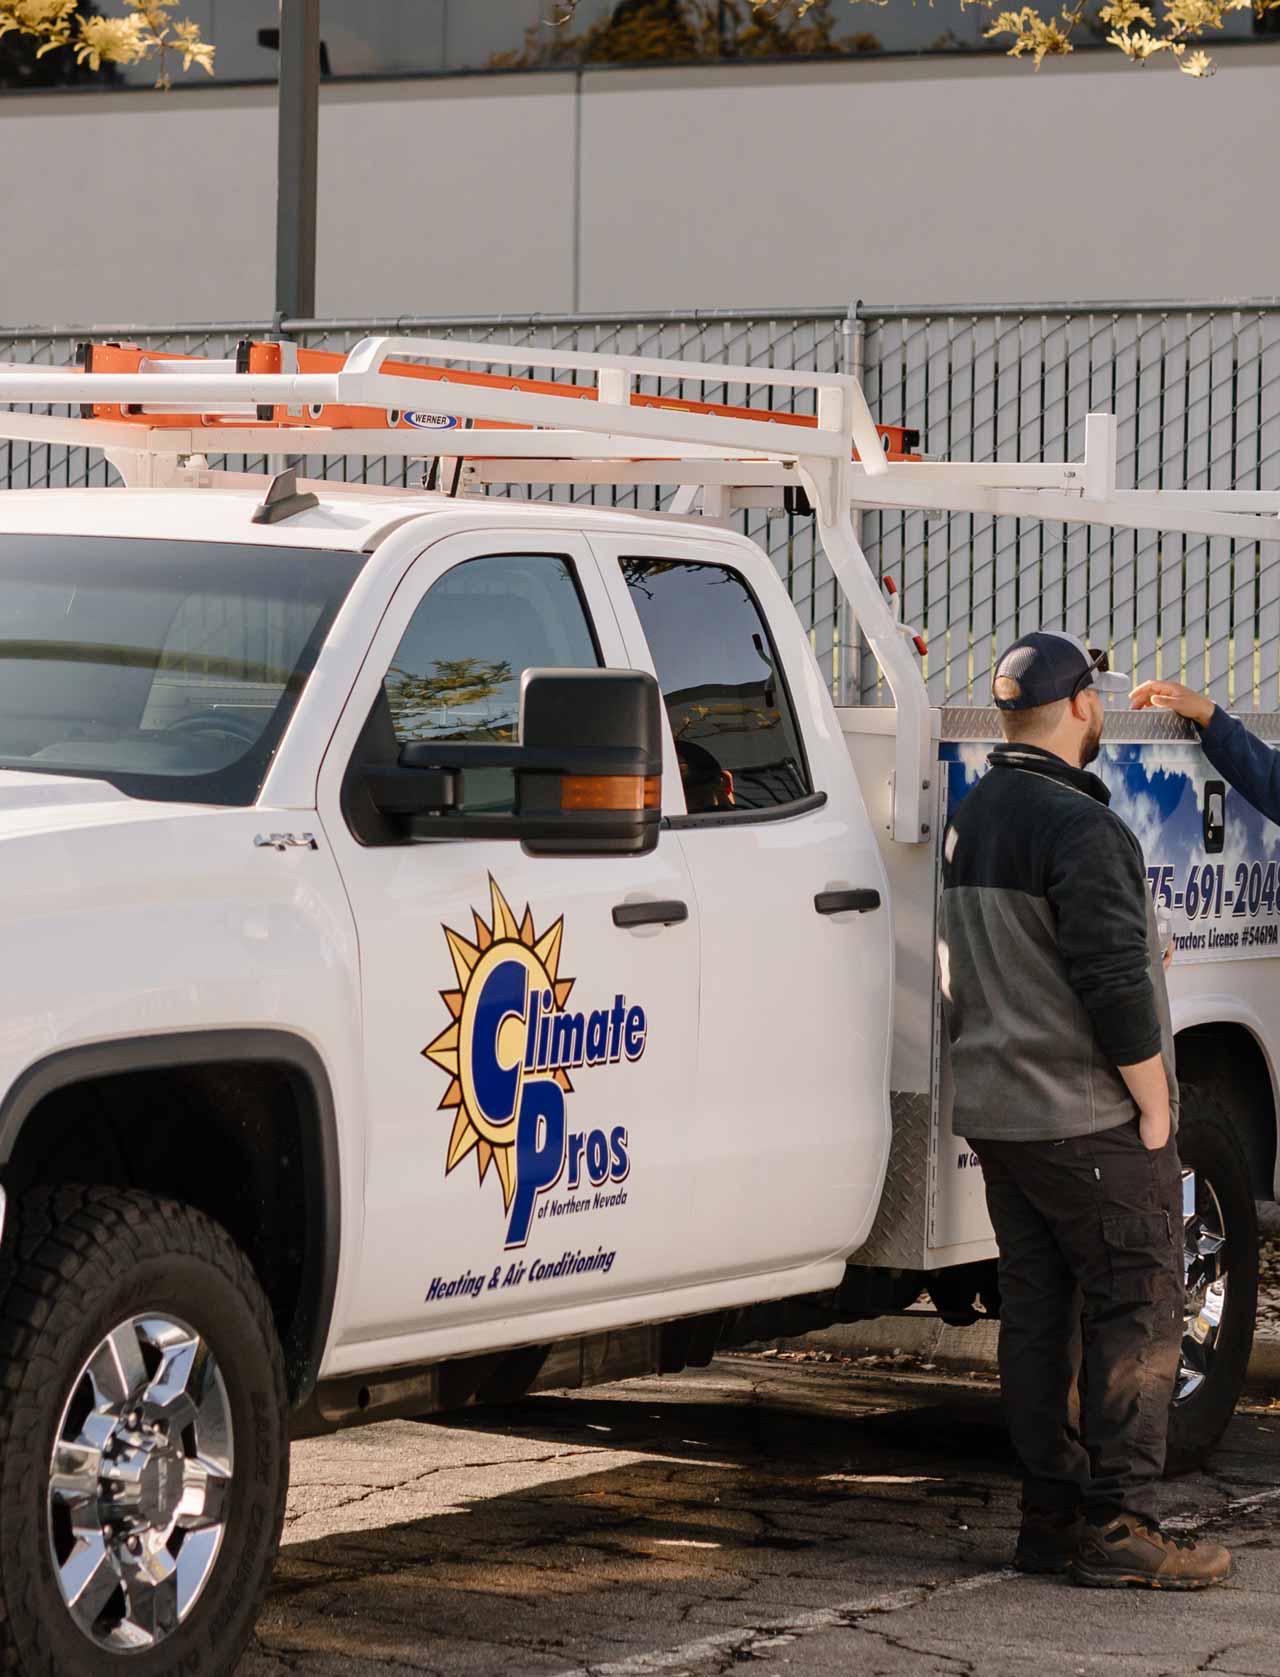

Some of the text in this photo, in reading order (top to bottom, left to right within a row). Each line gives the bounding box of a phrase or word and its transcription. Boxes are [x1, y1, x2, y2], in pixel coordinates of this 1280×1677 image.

[415, 414, 447, 424] WERNER
[1208, 928, 1239, 949] License
[471, 959, 647, 1123] Climate
[505, 1079, 630, 1250] Pros
[537, 1189, 627, 1219] of Northern Nevada
[424, 1246, 616, 1302] Heating & Air Conditioning
